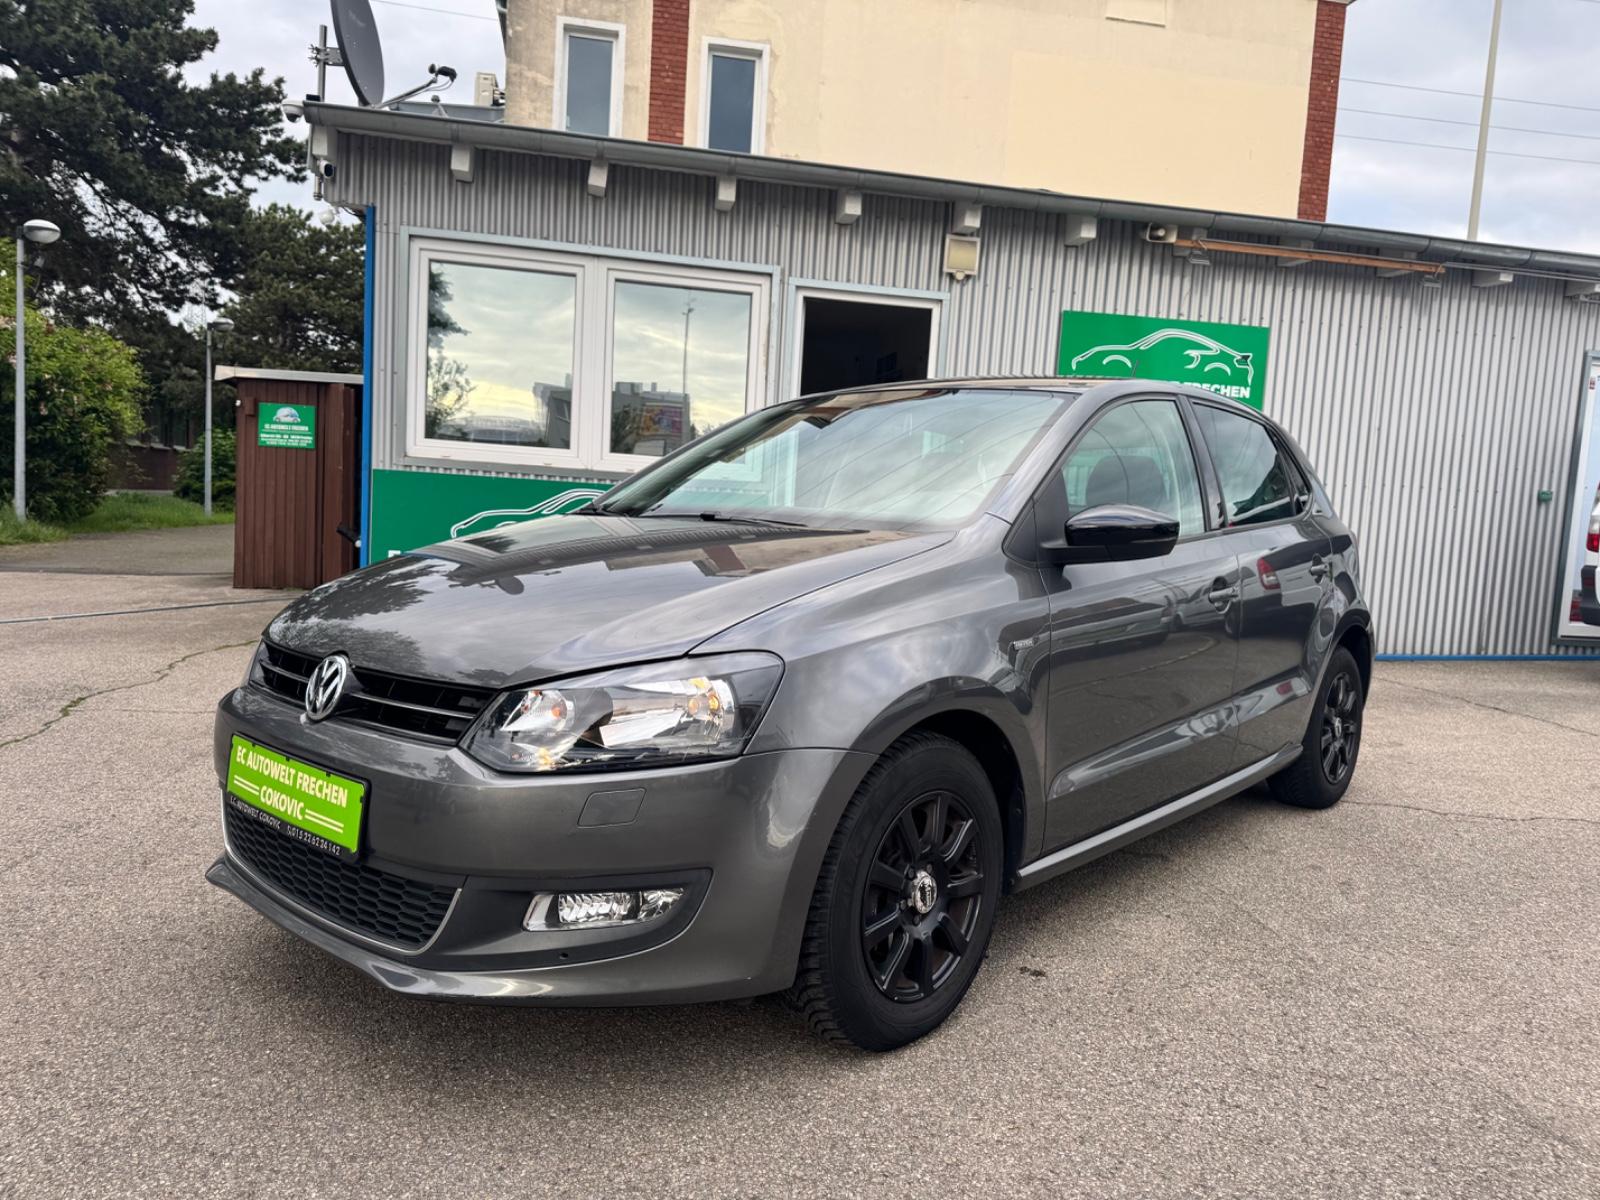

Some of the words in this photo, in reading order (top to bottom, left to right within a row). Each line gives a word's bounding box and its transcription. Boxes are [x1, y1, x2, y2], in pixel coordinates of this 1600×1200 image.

[1183, 381, 1251, 399] ECHEN
[236, 745, 246, 764] EC
[246, 751, 296, 787] AUTOWELT
[296, 771, 348, 808] FRECHEN
[260, 785, 305, 820] COKOVIC
